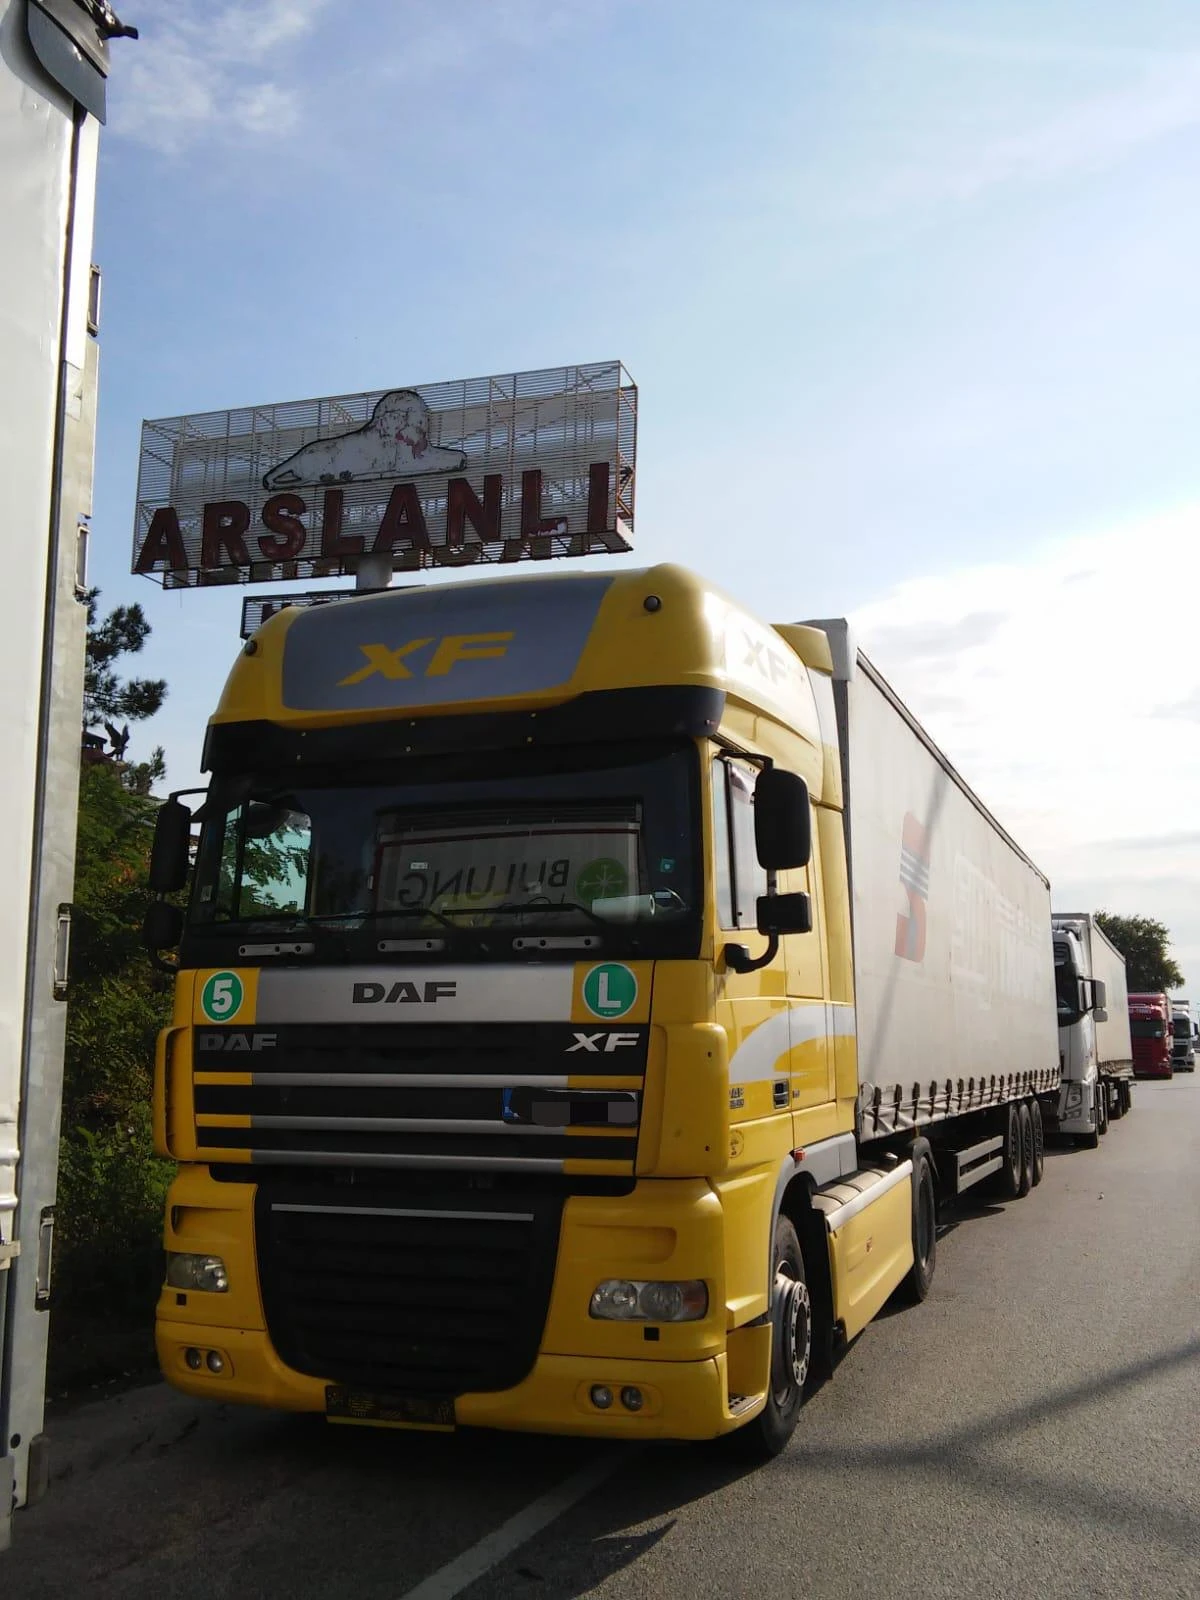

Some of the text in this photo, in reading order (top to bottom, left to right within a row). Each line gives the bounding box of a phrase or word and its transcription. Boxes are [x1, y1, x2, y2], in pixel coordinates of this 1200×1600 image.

[137, 463, 610, 571] ARSLANLI
[336, 632, 515, 687] XF
[741, 628, 788, 686] XF
[211, 979, 233, 1013] 5
[352, 982, 456, 1003] DAF
[598, 972, 622, 1008] L
[200, 1033, 277, 1051] DAF
[564, 1033, 640, 1051] XF
